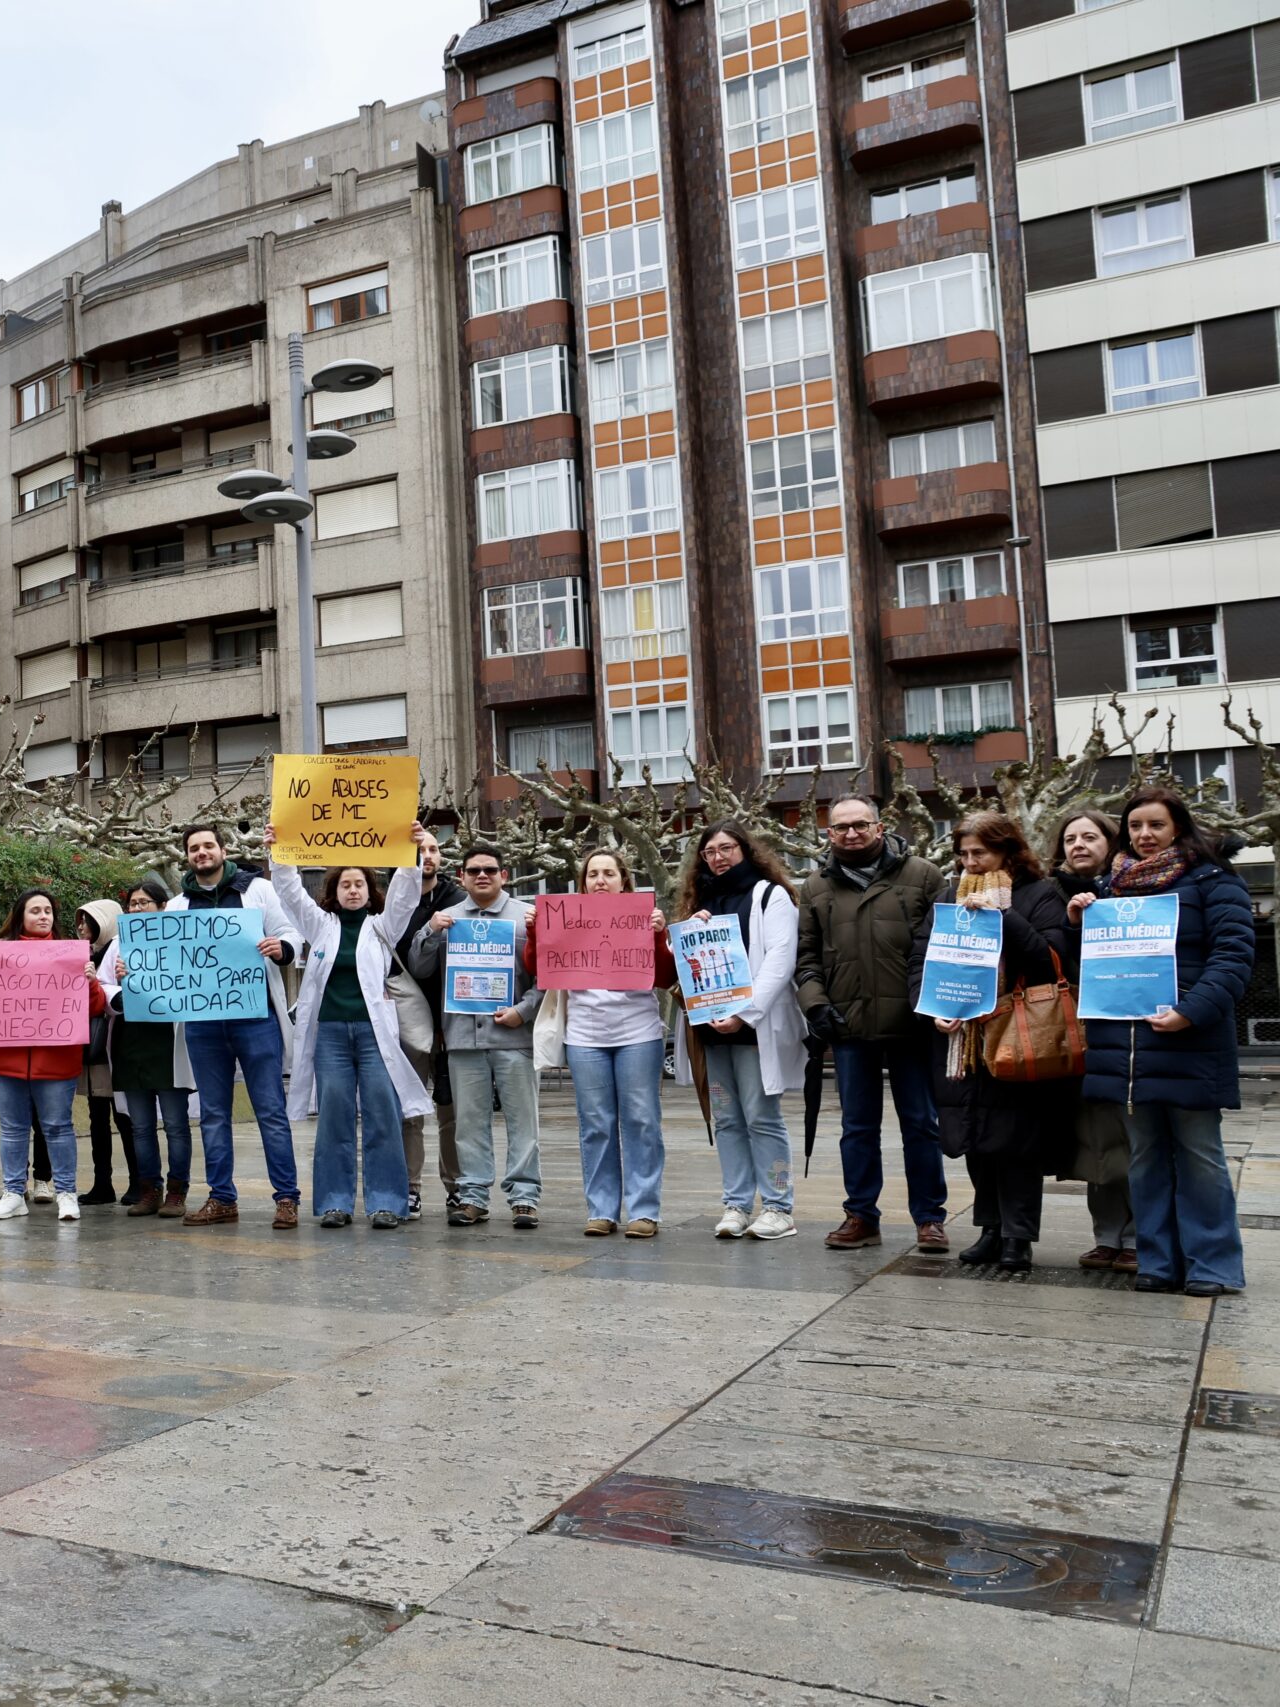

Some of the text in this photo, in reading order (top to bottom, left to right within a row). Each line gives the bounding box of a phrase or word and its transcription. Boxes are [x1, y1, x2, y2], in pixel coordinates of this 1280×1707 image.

[288, 778, 389, 799] NO ABUSES
[312, 803, 367, 822] DE MI
[300, 828, 387, 848] VOCACIÓN
[545, 900, 602, 930] Médico
[680, 928, 732, 950] ¡YO PARO!
[930, 932, 998, 950] HUELGA MÉDICA
[1084, 924, 1170, 940] HUELGA MÉDICA
[448, 942, 511, 954] HUELGA MÉDICA
[547, 948, 656, 968] PACIENTE AFECTADO
[128, 945, 218, 972] QUE NOS
[127, 967, 264, 994] CUIDEN PARA
[61, 998, 81, 1014] EN
